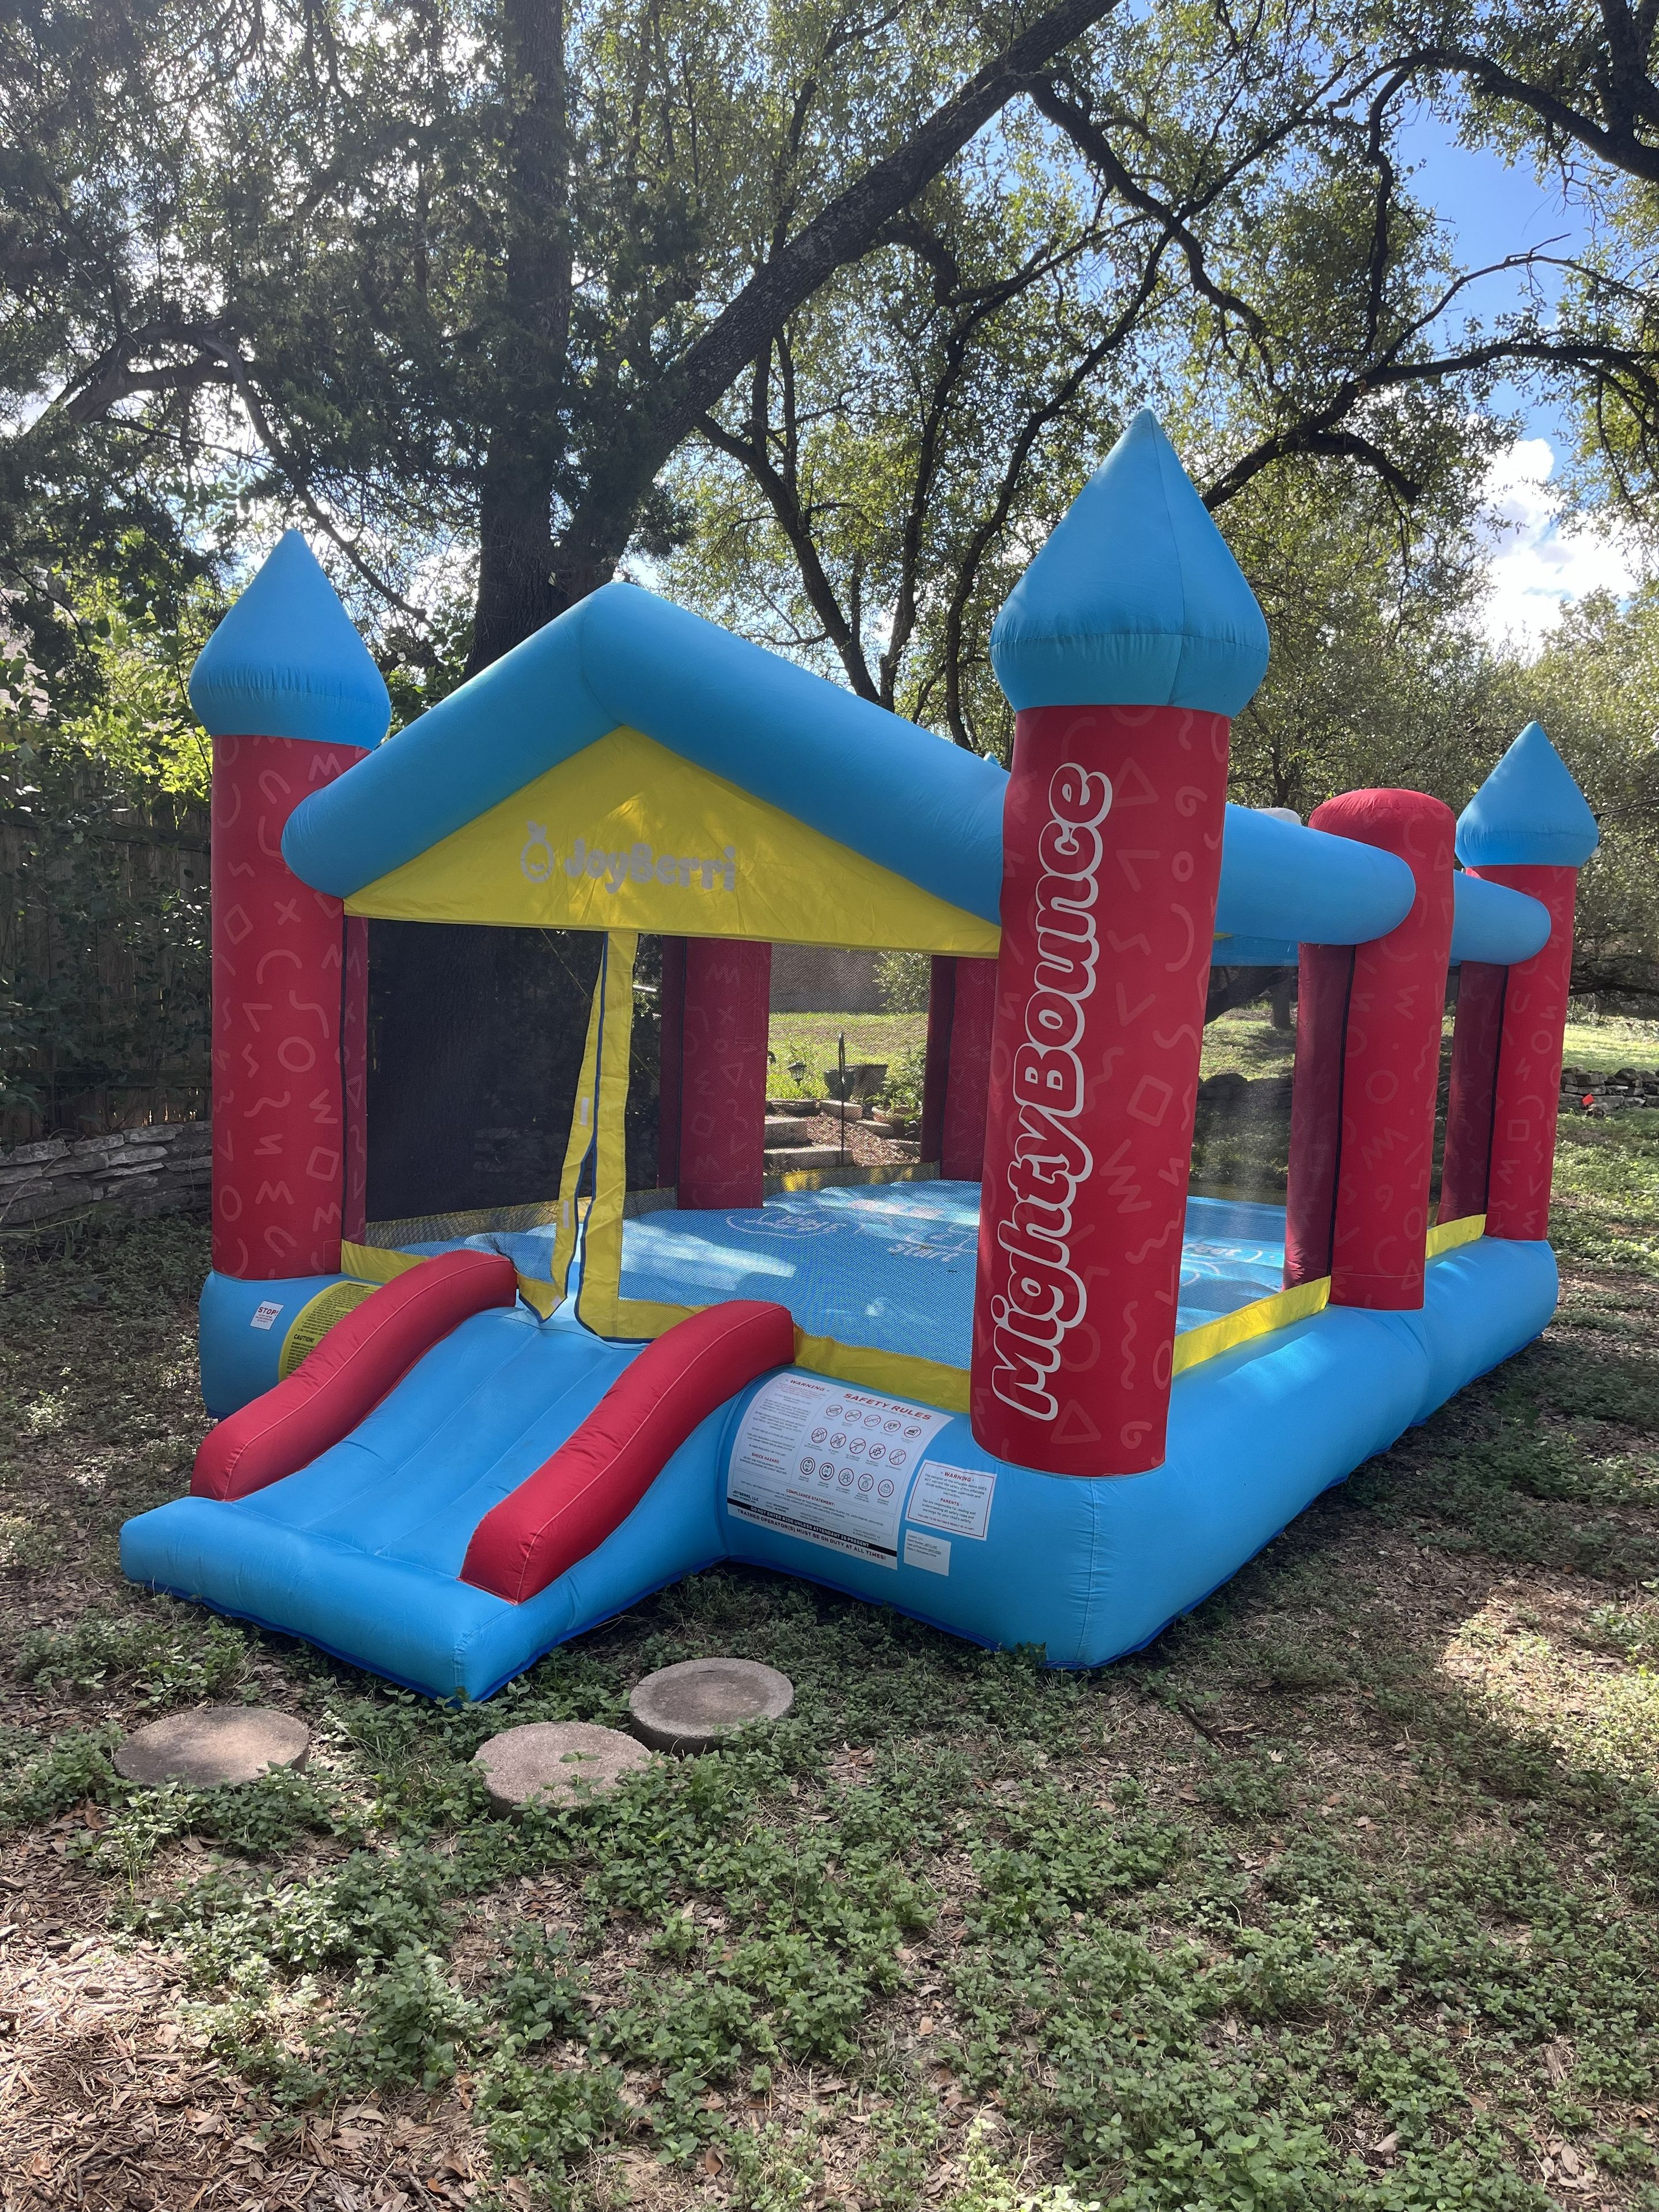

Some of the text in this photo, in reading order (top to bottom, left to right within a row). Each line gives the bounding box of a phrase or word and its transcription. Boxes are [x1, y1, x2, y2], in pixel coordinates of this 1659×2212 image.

[564, 838, 736, 895] JoyBerri
[990, 760, 1113, 1422] MightyBounce
[258, 1307, 279, 1316] STOP!
[294, 1334, 315, 1343] CAUTION!
[790, 1379, 825, 1391] WARNING
[843, 1393, 890, 1408] SAFETY
[891, 1404, 932, 1420] RULES
[751, 1452, 779, 1464] SHOCK HAZARD
[944, 1471, 971, 1482] WARNING
[786, 1488, 811, 1499] COMPLIANCE
[940, 1498, 960, 1506] PARENTS
[737, 1508, 760, 1521] TRAINED
[760, 1517, 796, 1532] OPERATOR(S)
[797, 1528, 811, 1536] MUST
[830, 1539, 844, 1547] DUTY
[866, 1550, 886, 1560] TIMES!
[767, 1510, 782, 1520] ENTER
[782, 1515, 794, 1524] RIDE
[794, 1519, 812, 1529] UNLESS
[813, 1527, 840, 1540] ATTENDANT
[847, 1536, 870, 1548] PRESENT
